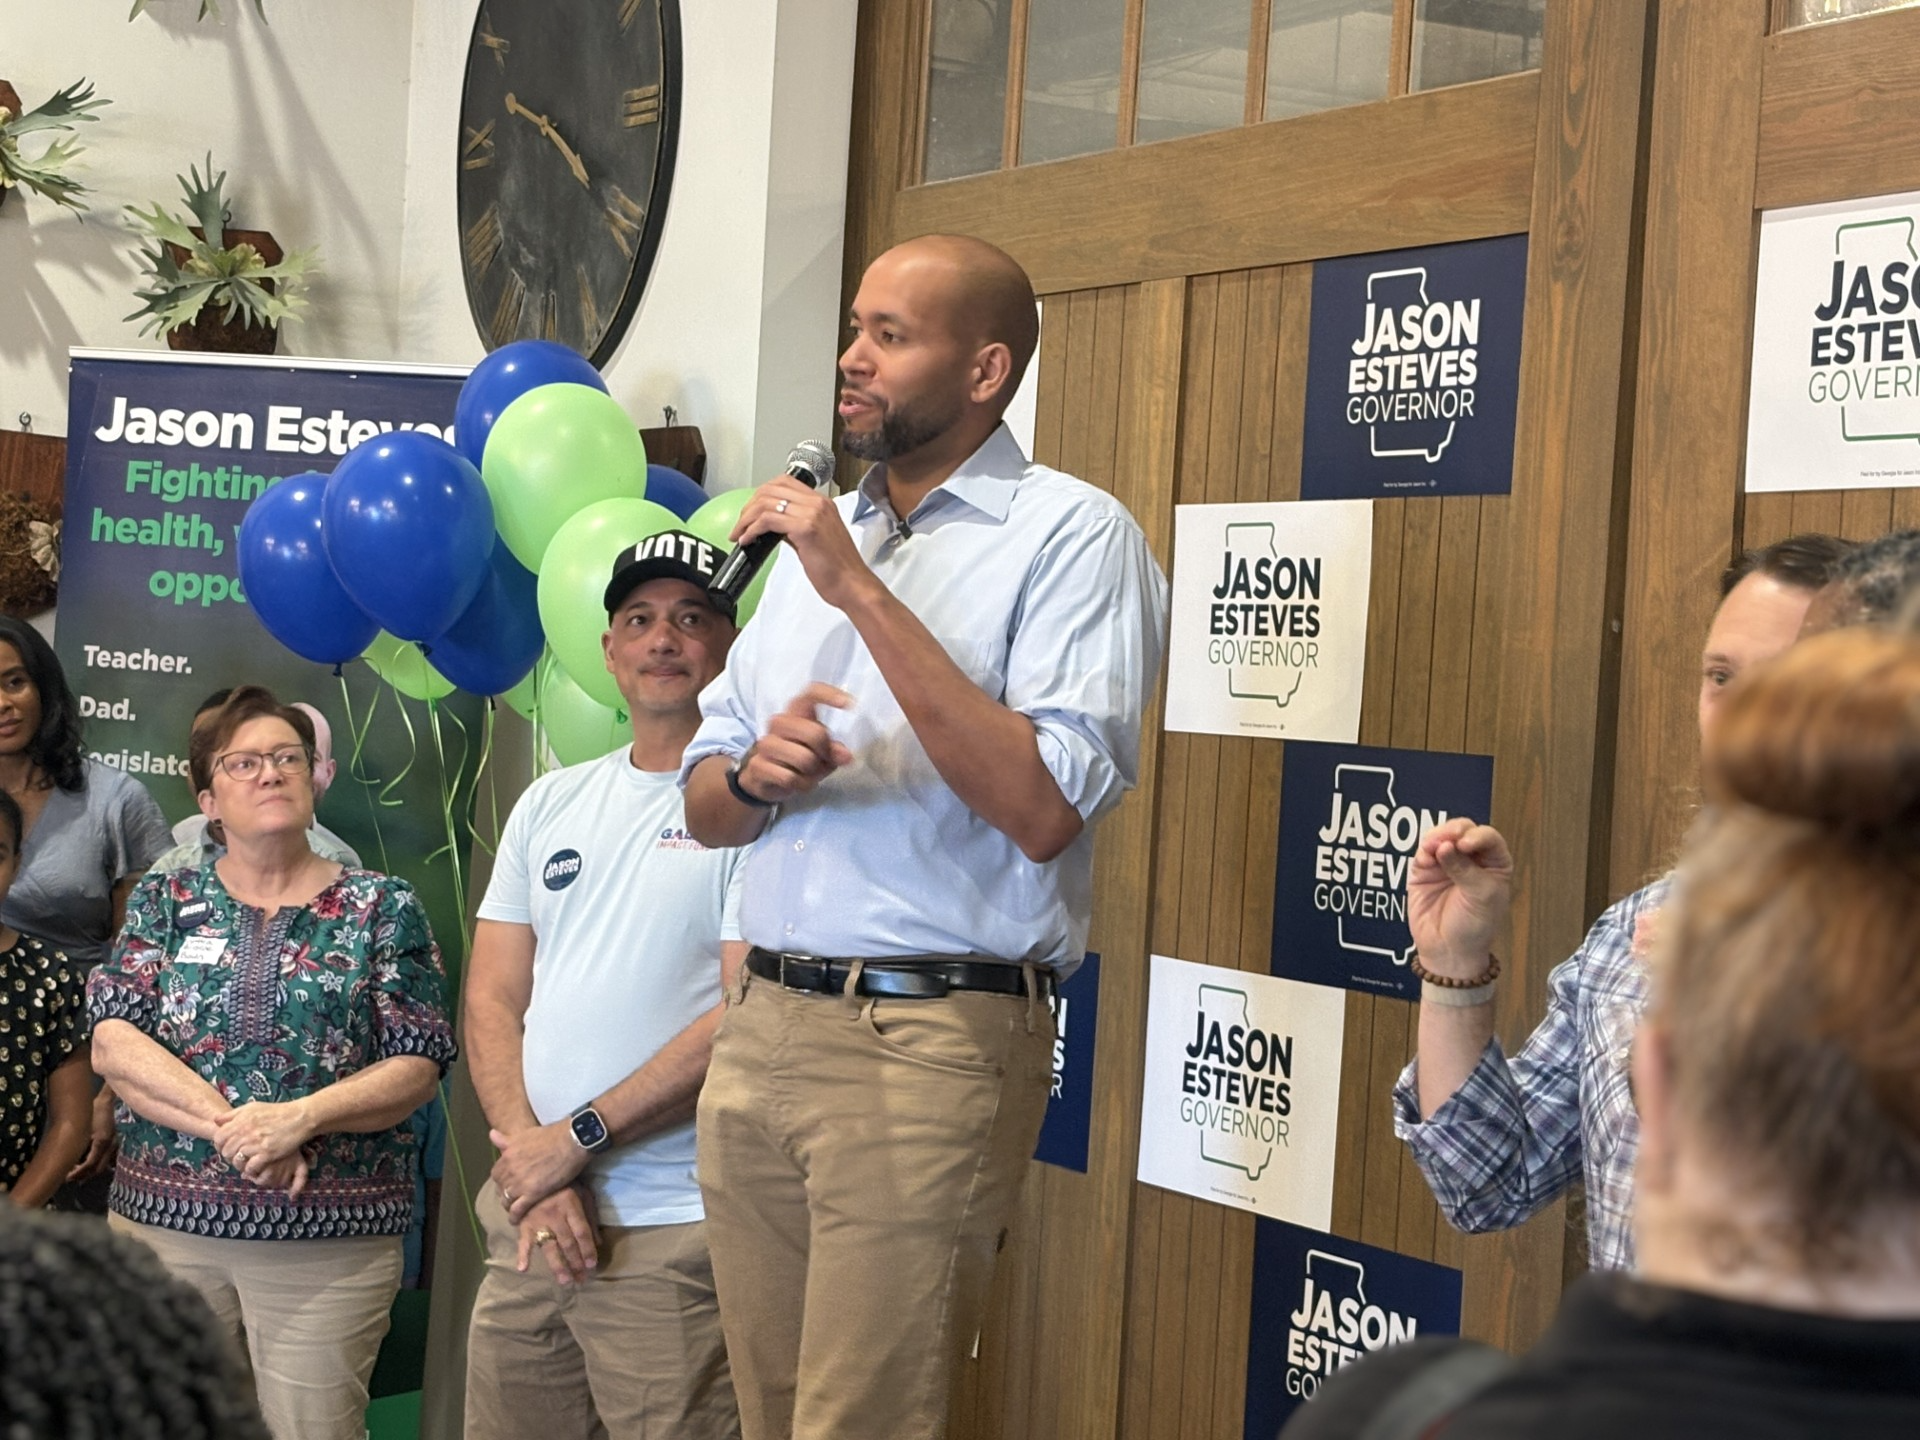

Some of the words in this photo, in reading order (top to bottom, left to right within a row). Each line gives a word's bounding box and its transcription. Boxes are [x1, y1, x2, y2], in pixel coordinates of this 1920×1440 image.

[1351, 298, 1481, 356] JASON
[1348, 348, 1478, 394] ESTEVES
[1808, 363, 1920, 404] GOVER
[94, 396, 254, 450] Jason
[265, 405, 456, 456] Este
[1346, 388, 1475, 424] GOVERNOR
[126, 460, 284, 503] Fightin
[90, 507, 225, 557] health,
[634, 533, 714, 576] VOTE
[1212, 551, 1322, 600] JASON
[1209, 603, 1321, 638] ESTEVES
[84, 644, 193, 674] Teacher.
[1208, 639, 1319, 668] GOVERNOR
[79, 695, 137, 721] Dad.
[547, 856, 580, 874] JASON
[1315, 844, 1415, 891] ESTEV
[1185, 1010, 1293, 1079] JASON
[1181, 1060, 1291, 1116] ESTEVES
[1180, 1096, 1290, 1147] GOVERNOR
[1290, 1277, 1417, 1351] JASON
[1287, 1328, 1364, 1376] ESTE
